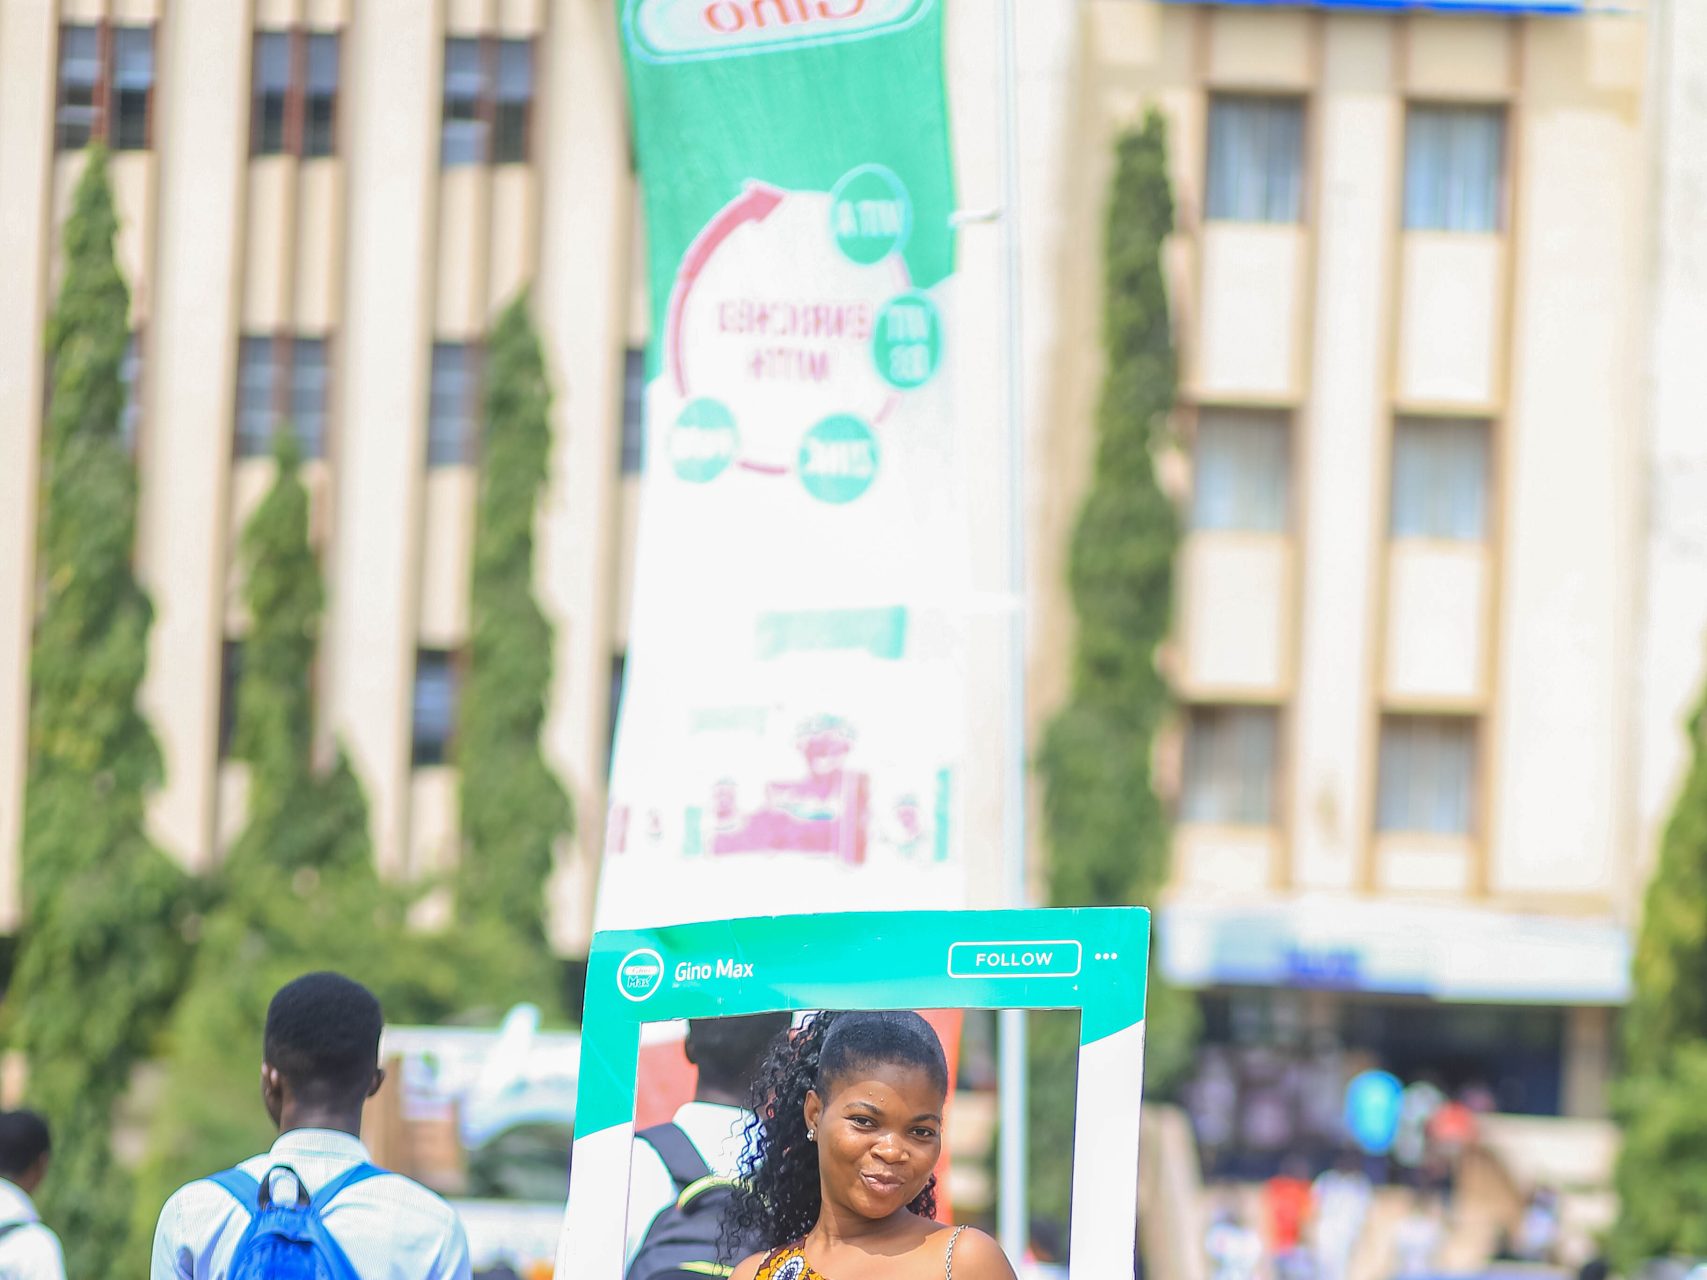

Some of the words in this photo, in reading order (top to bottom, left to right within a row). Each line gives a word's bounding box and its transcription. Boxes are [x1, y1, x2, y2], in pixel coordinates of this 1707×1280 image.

[975, 952, 1053, 967] FOLLOW
[674, 962, 712, 982] Gino
[715, 958, 754, 979] Max
[627, 975, 653, 988] Max
